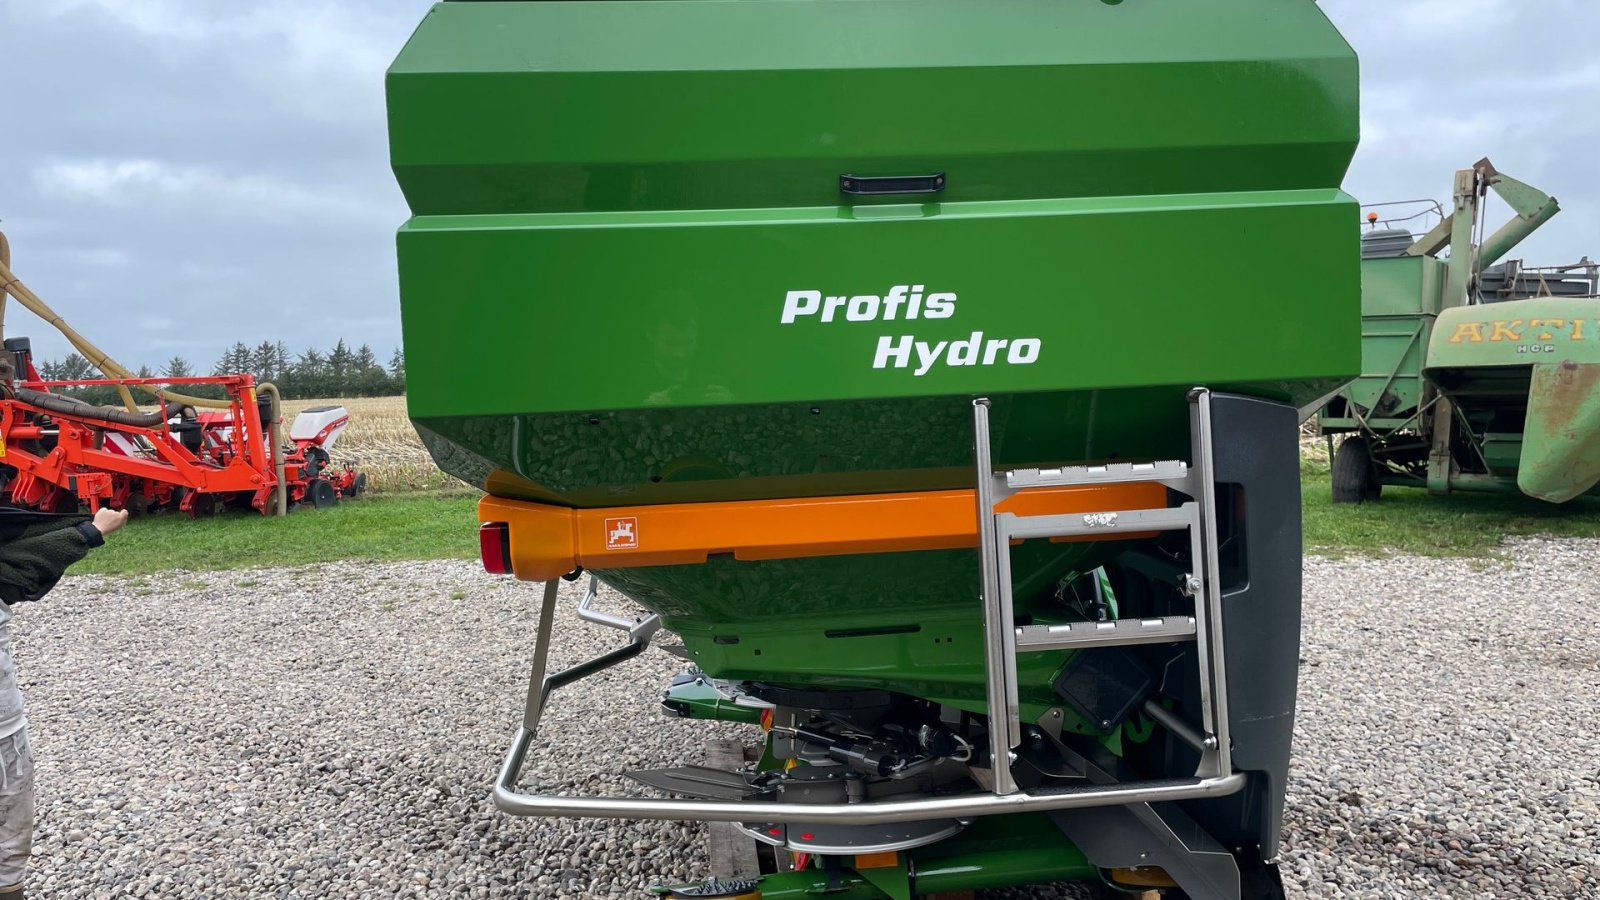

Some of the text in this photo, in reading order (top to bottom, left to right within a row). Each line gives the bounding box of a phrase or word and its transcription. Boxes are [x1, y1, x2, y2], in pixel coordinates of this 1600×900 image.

[780, 284, 957, 324] Profis
[1449, 318, 1600, 343] AKTI
[872, 331, 1042, 376] Hydro
